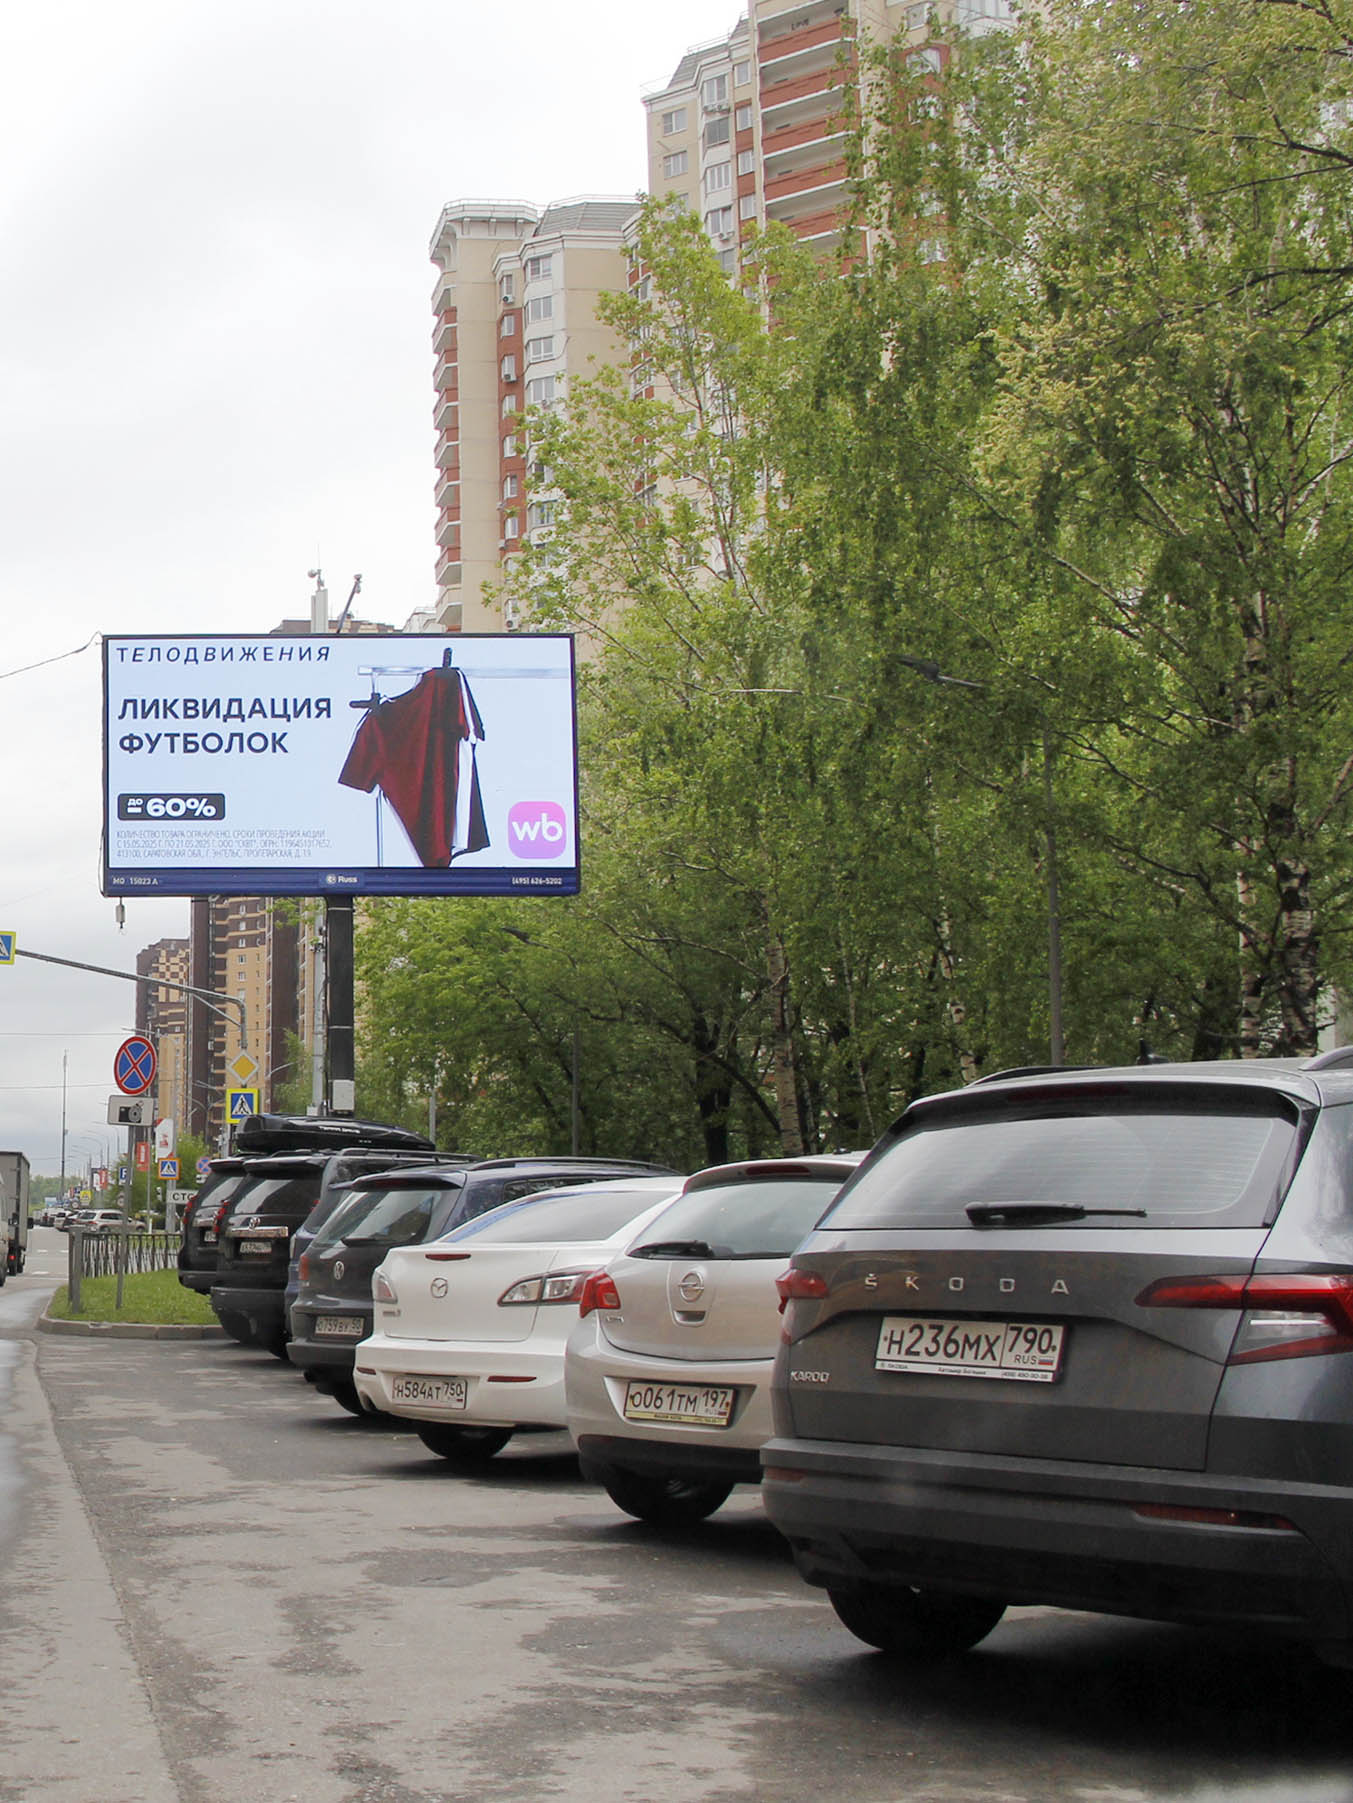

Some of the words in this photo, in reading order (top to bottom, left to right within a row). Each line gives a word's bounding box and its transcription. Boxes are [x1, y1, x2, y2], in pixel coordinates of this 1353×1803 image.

[116, 646, 331, 665] ТЕЛОДВИЖЕНИЯ
[117, 697, 332, 723] ЛИКВИДАЦИЯ
[118, 731, 289, 754] ФУТБОЛОК
[511, 812, 563, 843] wb
[338, 875, 358, 883] Russ
[511, 876, 529, 885] (495)
[887, 1323, 1001, 1361] Н236МХ
[1008, 1326, 1054, 1354] 790
[1014, 1354, 1037, 1365] RUS
[790, 1370, 830, 1383] KAROQ
[396, 1381, 441, 1400] Н584АТ
[444, 1383, 462, 1397] 750
[702, 1389, 728, 1408] 197
